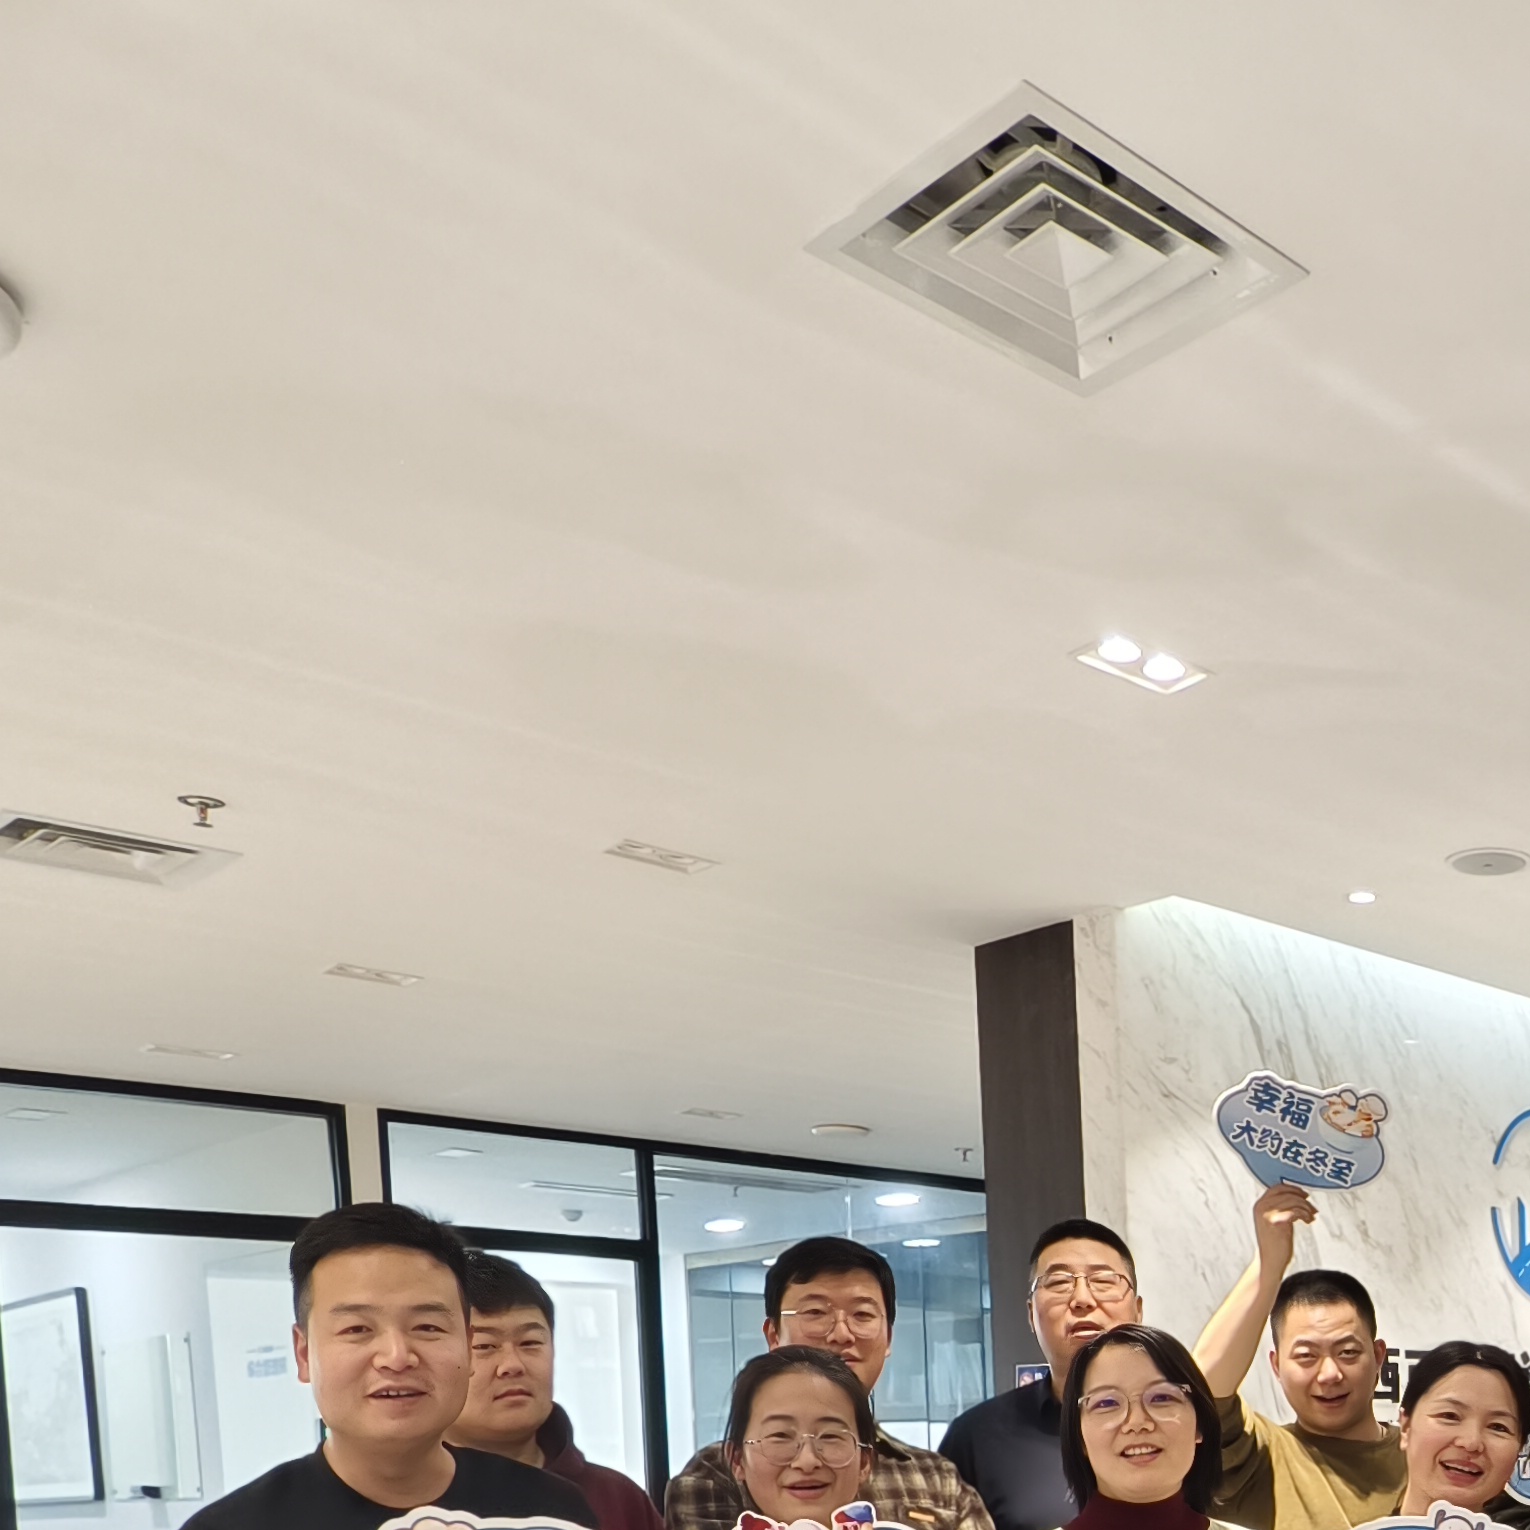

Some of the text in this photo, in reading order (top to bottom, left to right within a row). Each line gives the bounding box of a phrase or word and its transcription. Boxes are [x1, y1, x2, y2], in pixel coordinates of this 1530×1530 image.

[1246, 1081, 1315, 1131] 幸福
[1231, 1120, 1355, 1186] 大约在冬至
